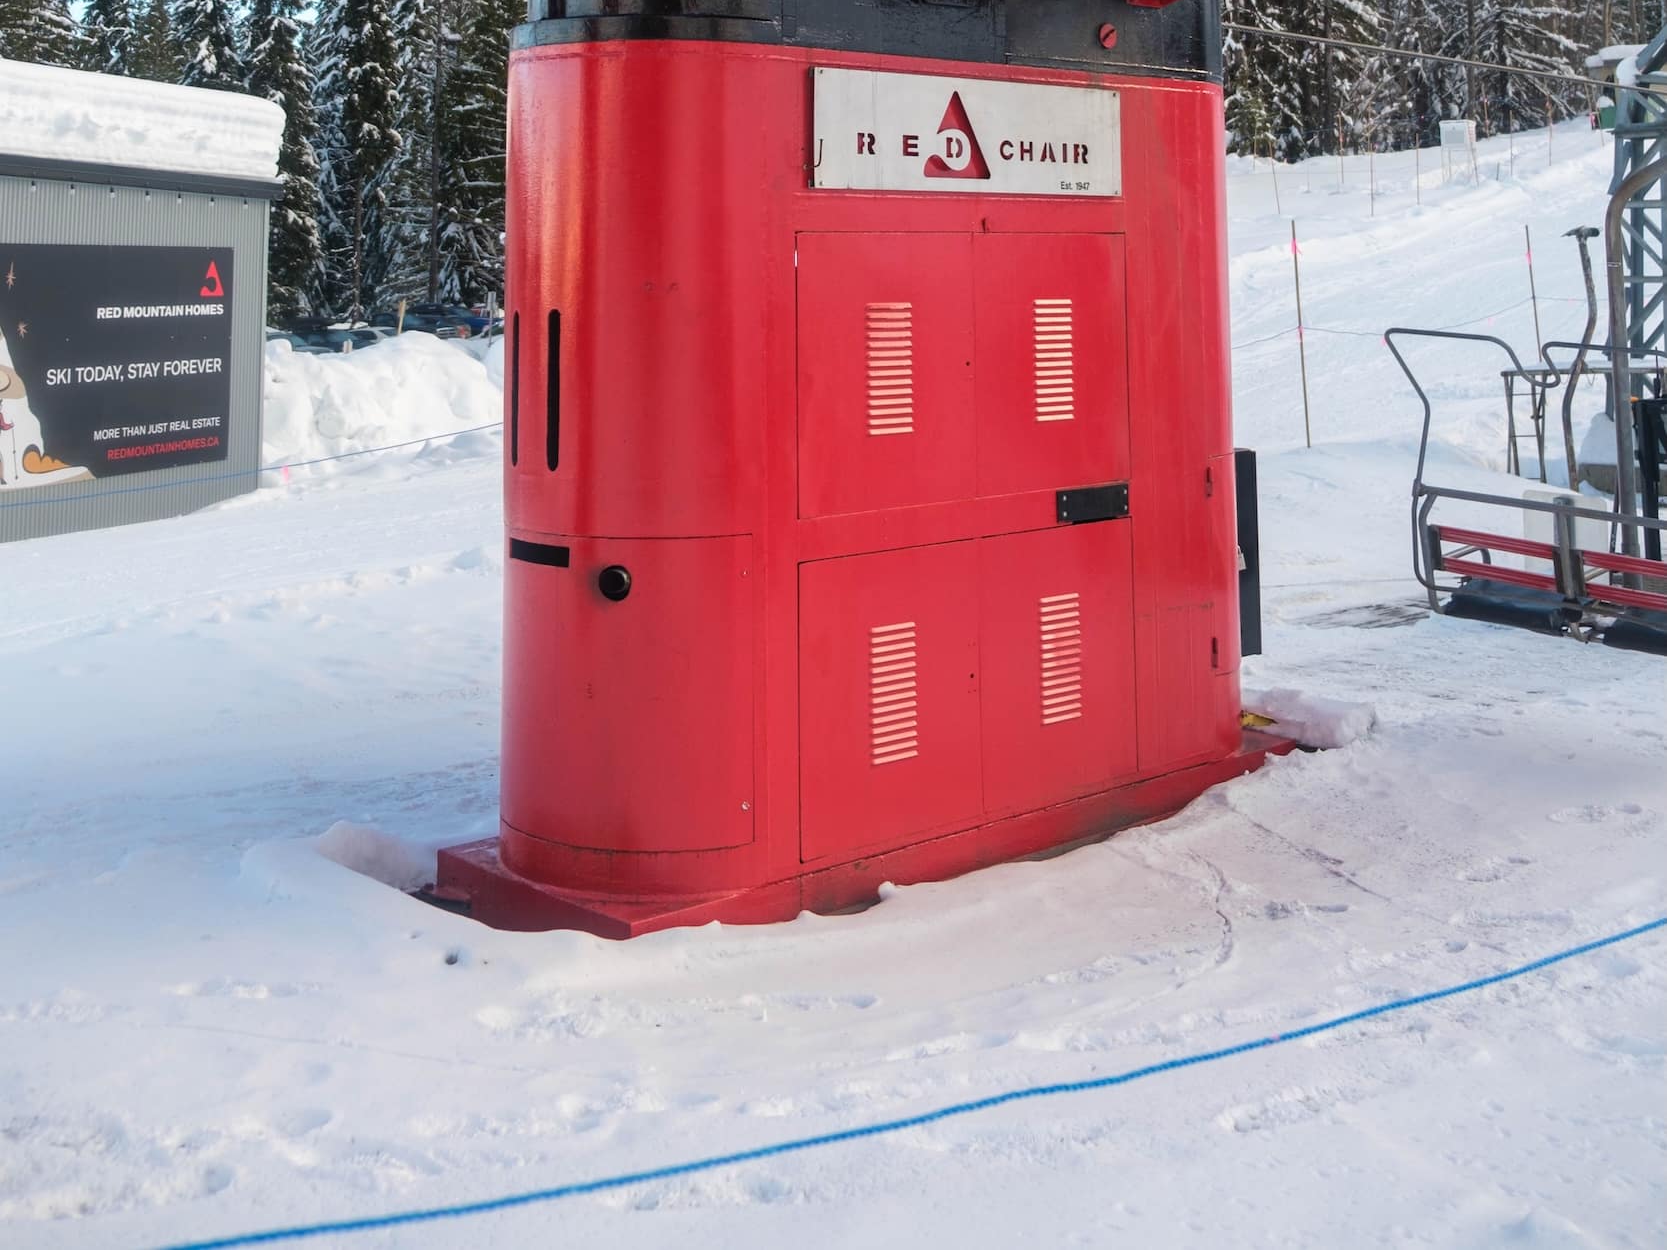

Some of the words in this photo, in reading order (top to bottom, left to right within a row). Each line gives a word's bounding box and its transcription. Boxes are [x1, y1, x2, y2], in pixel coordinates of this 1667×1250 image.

[856, 132, 963, 158] RED
[1000, 140, 1089, 164] CHAIR
[1075, 181, 1090, 191] 1947
[97, 306, 121, 319] RED
[123, 305, 183, 318] MOUNTAIN
[185, 304, 224, 316] HOMES
[46, 368, 71, 385] SKI
[75, 365, 124, 383] TODAY,
[127, 362, 160, 379] STAY
[163, 358, 222, 376] FOREVER
[93, 430, 120, 441] MORE
[122, 426, 146, 437] THAN
[147, 423, 168, 434] JUST
[169, 420, 190, 431] REAL
[192, 417, 221, 428] ESTATE
[107, 438, 219, 460] REDMOUNTAINHOMES.CA
